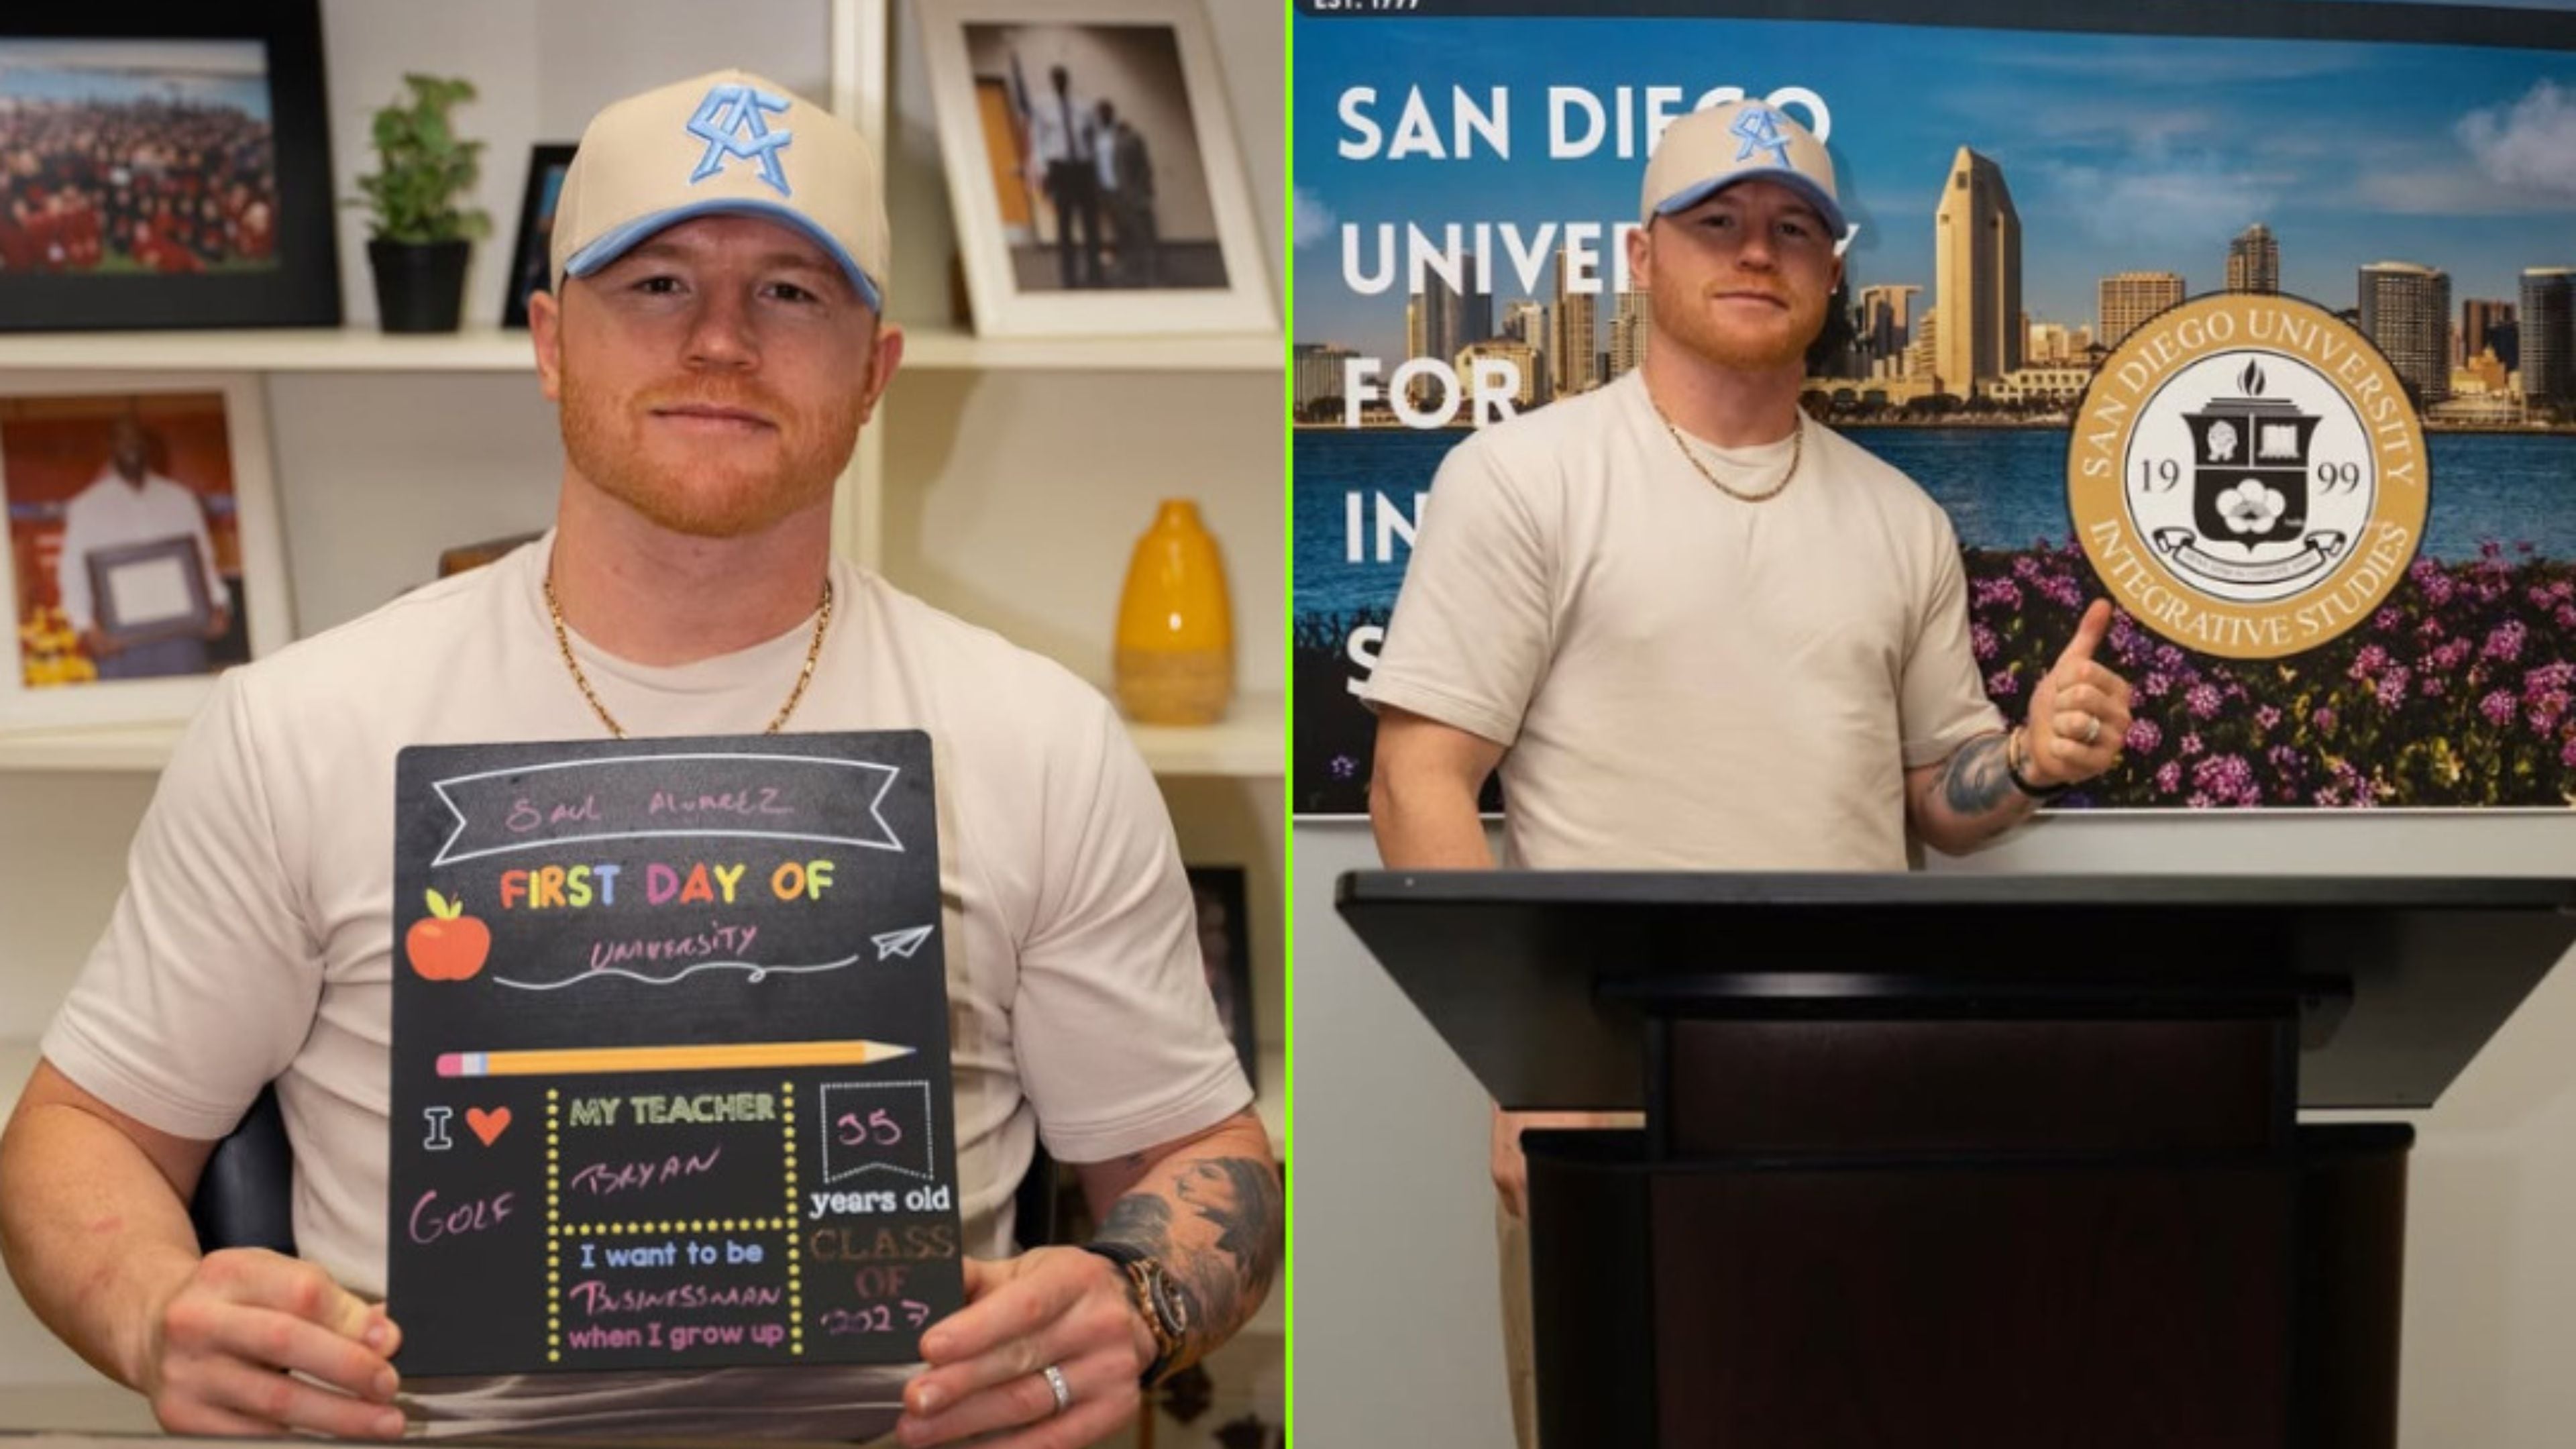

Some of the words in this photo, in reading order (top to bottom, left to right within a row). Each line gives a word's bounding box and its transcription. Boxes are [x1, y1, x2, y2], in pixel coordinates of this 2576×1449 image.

[1338, 85, 1511, 161] SAN
[1344, 356, 1521, 429] FOR
[2083, 394, 2128, 479] SAN
[2116, 311, 2234, 393] DIEGO
[2247, 309, 2415, 486] UNIVERSITY
[2140, 459, 2180, 493] 19
[2316, 463, 2361, 496] 99
[2090, 519, 2292, 646] INTEGRATIVE
[2294, 523, 2408, 636] STUDIES
[500, 864, 621, 910] FIRST
[645, 861, 745, 906] DAY
[771, 859, 836, 902] OF
[423, 1106, 453, 1150] I
[569, 1098, 621, 1127] MY
[629, 1093, 777, 1124] TEACHER
[570, 1144, 722, 1195] BRYAN
[808, 1190, 897, 1220] years
[904, 1185, 951, 1210] old
[580, 1244, 596, 1269] I
[605, 1241, 677, 1267] want
[686, 1241, 718, 1265] to
[725, 1239, 764, 1264] be
[810, 1226, 955, 1263] CLASS
[854, 1267, 908, 1299] OF
[569, 1324, 641, 1349] when
[648, 1323, 662, 1347] I
[669, 1324, 743, 1351] grow
[751, 1323, 785, 1349] up
